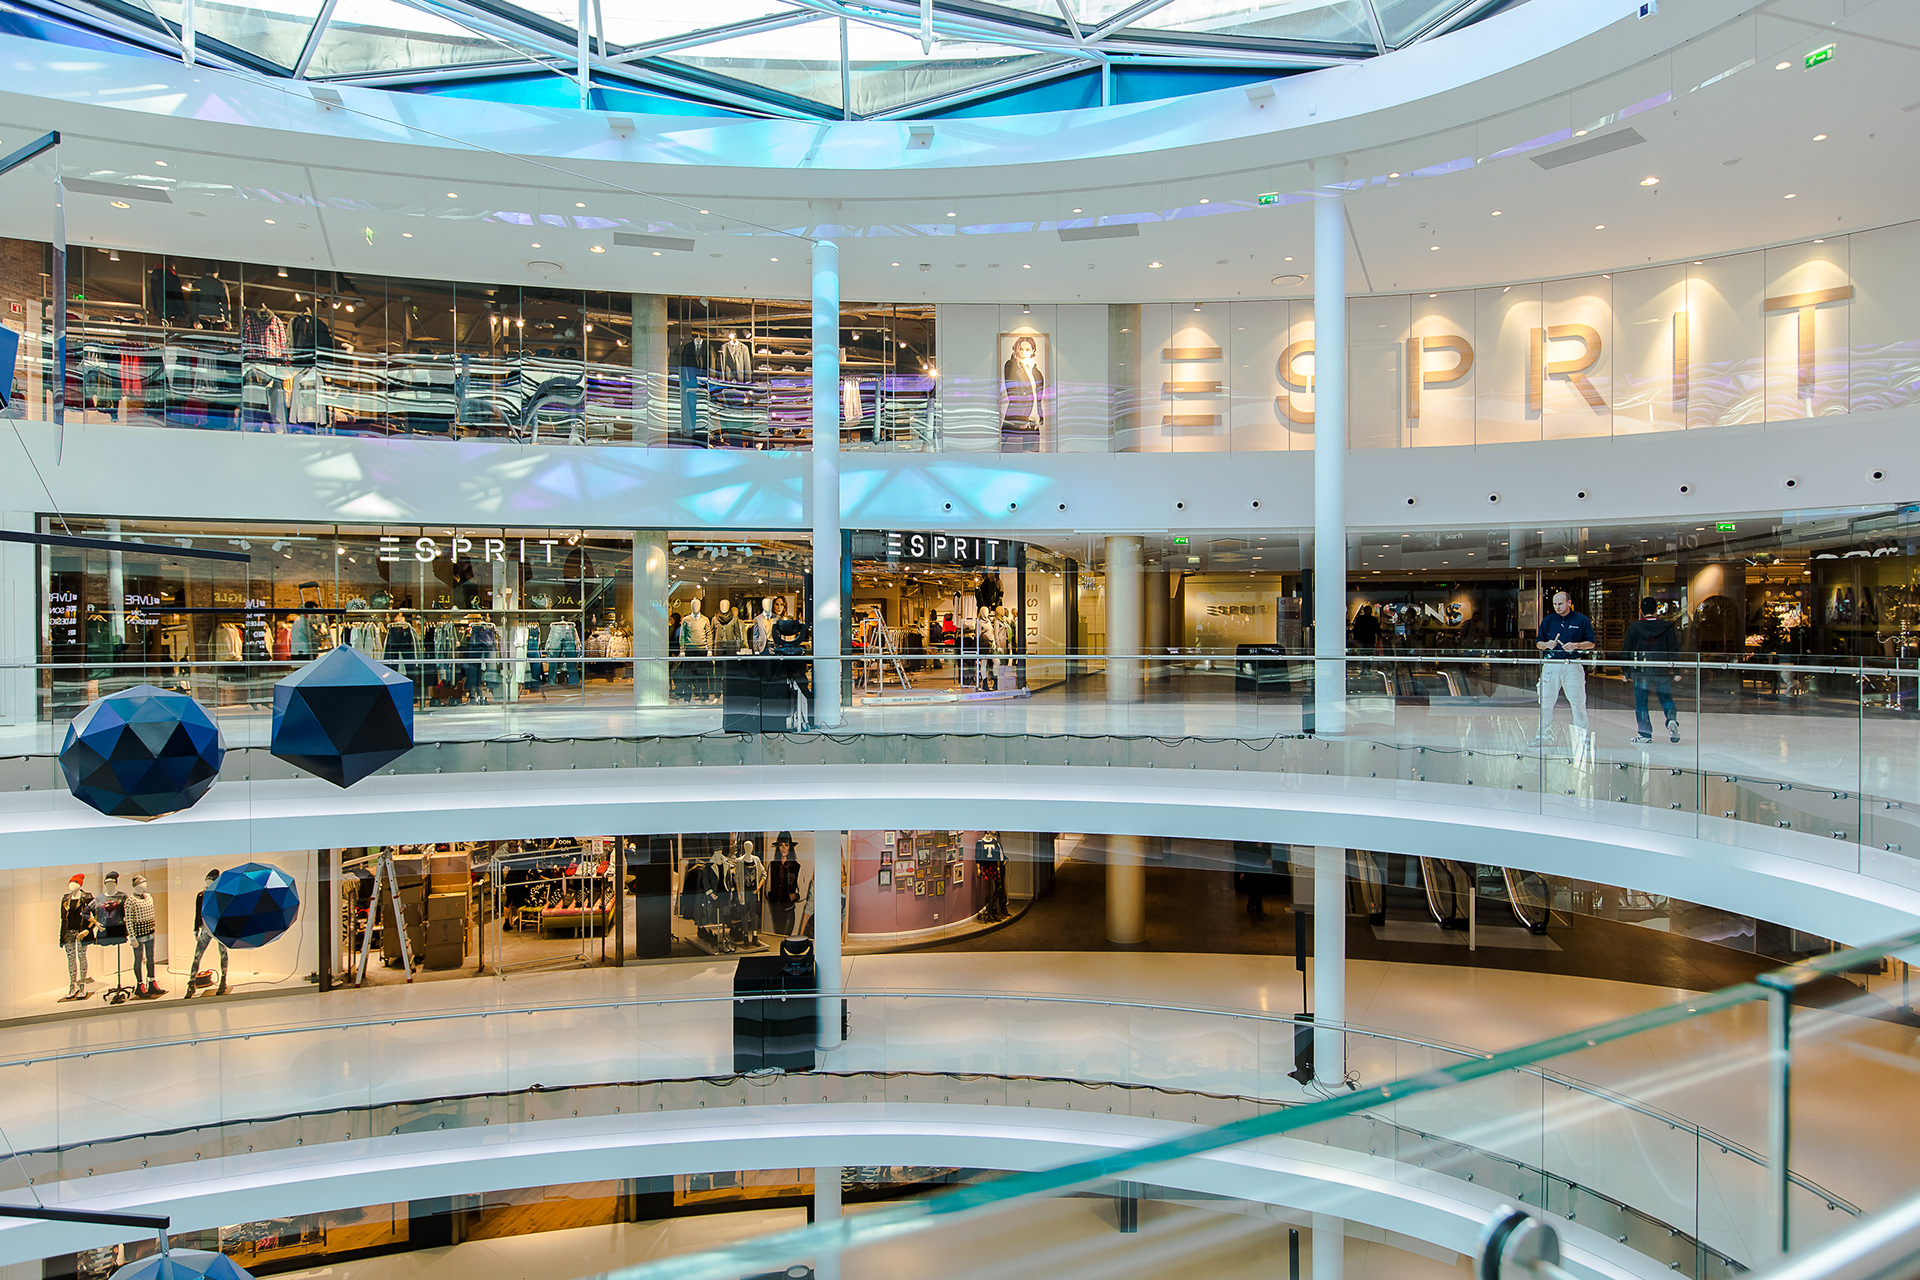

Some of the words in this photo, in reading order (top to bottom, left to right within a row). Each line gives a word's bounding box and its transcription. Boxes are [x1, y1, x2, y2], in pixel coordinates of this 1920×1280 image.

[1162, 285, 1855, 426] ESPRIT
[379, 537, 559, 564] ESPRIT
[886, 533, 1000, 561] ESPRIT
[1206, 605, 1268, 616] ESPRIT
[983, 843, 996, 858] T
